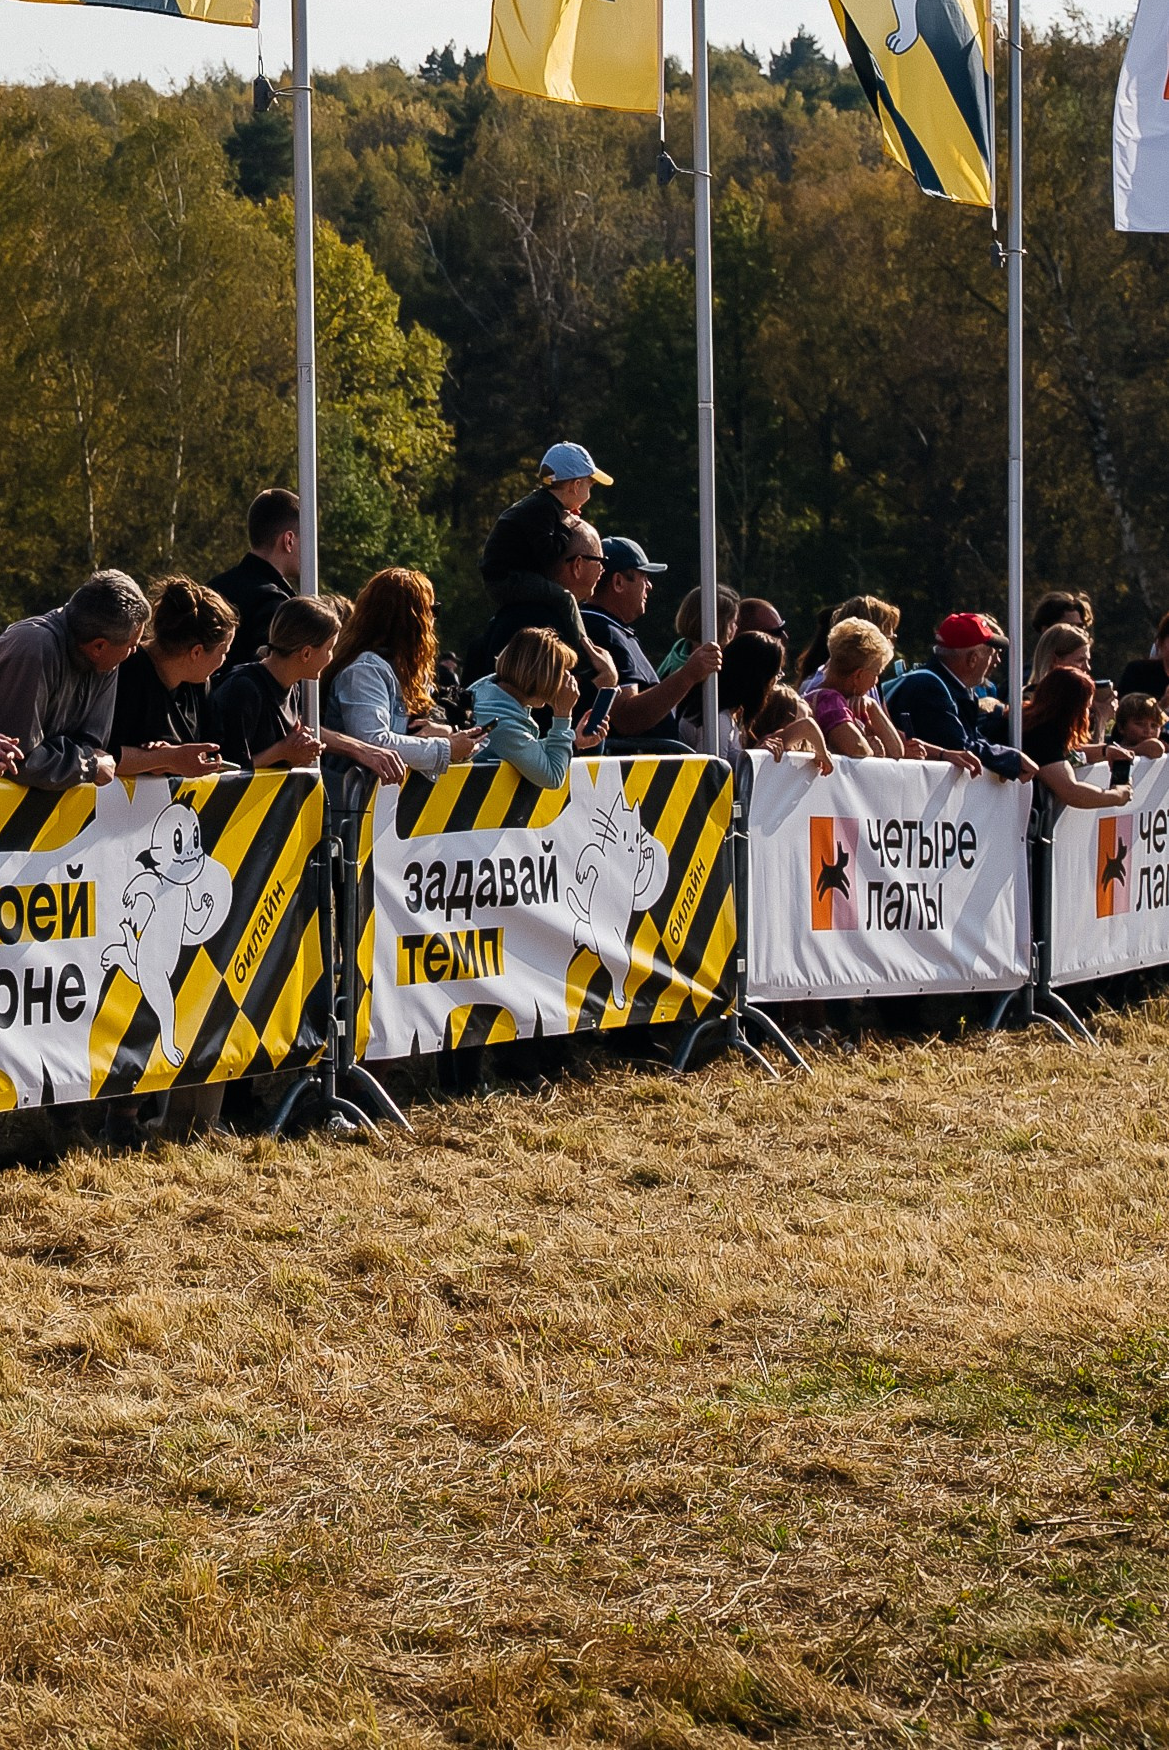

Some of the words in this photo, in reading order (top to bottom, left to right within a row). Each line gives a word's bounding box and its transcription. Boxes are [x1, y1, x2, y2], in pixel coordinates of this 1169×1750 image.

[866, 819, 977, 870] четыре
[1139, 809, 1169, 854] че
[403, 840, 559, 922] задавай
[669, 858, 706, 946] билайн
[866, 881, 944, 931] лапы
[1135, 863, 1169, 912] ла
[234, 879, 287, 984] билайн
[401, 929, 501, 984] темп
